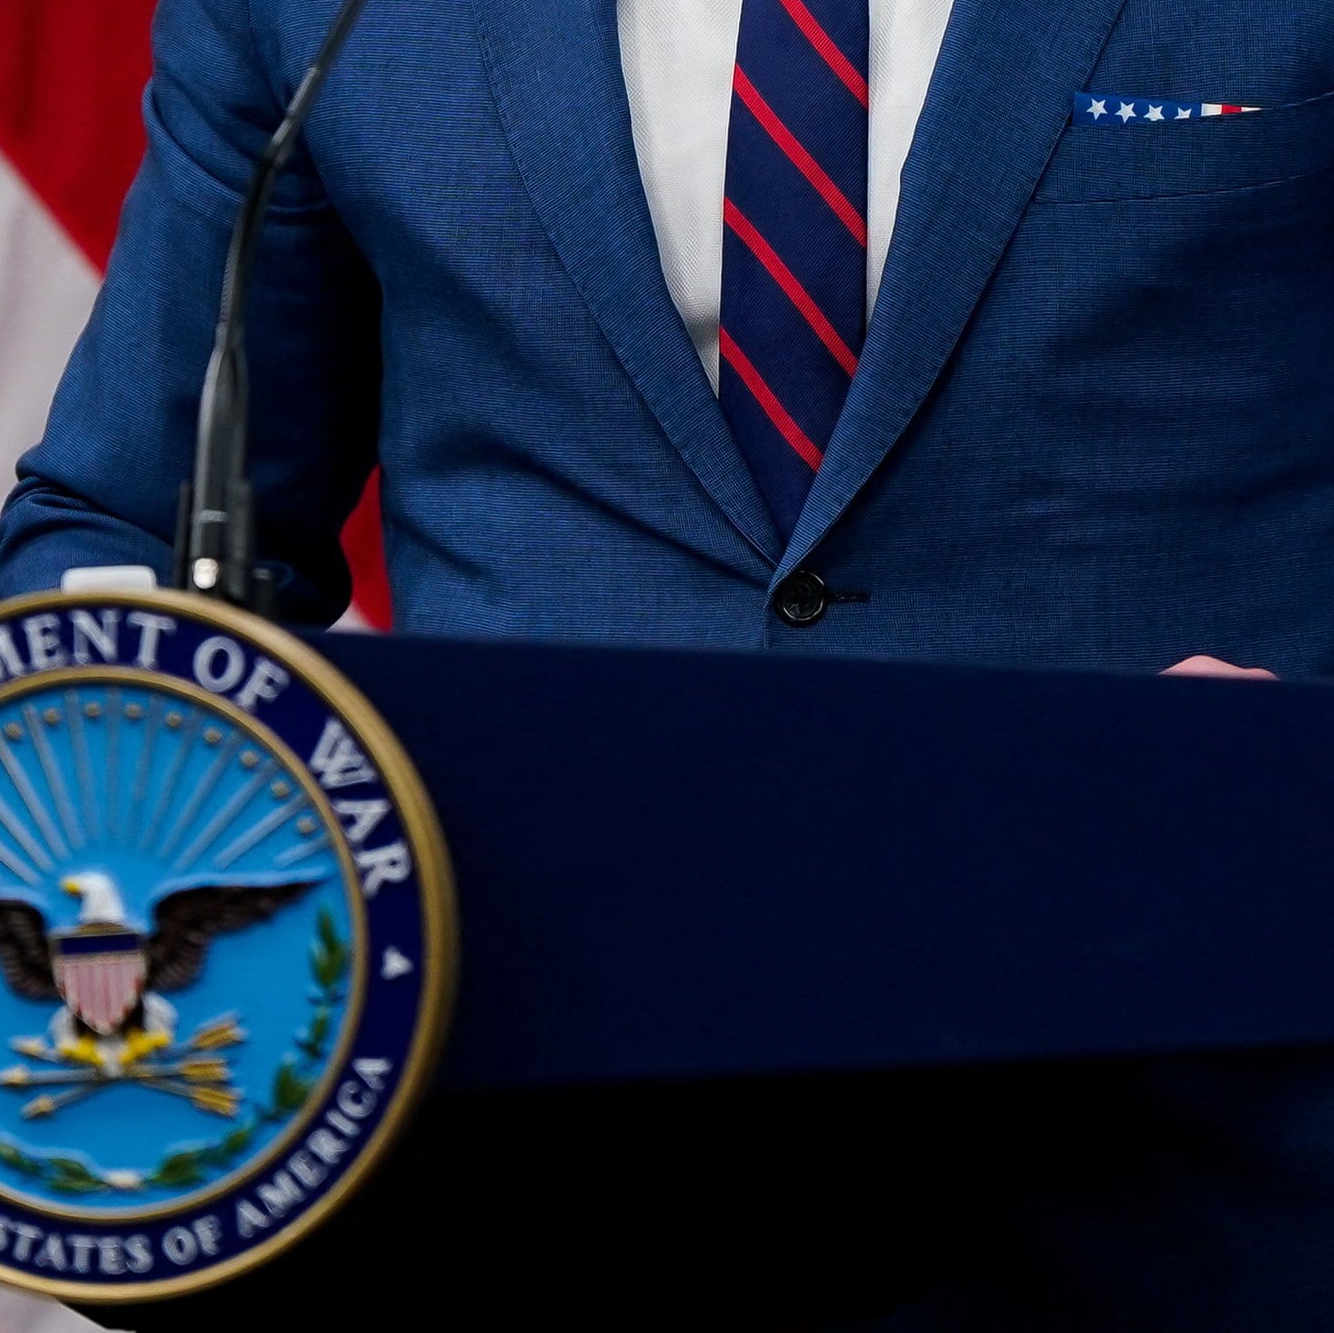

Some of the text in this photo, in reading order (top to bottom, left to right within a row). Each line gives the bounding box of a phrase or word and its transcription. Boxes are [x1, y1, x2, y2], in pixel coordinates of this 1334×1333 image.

[192, 636, 289, 710] OF
[309, 719, 411, 894] WAR
[162, 1220, 222, 1264] OF
[235, 1057, 392, 1237] AMERICA
